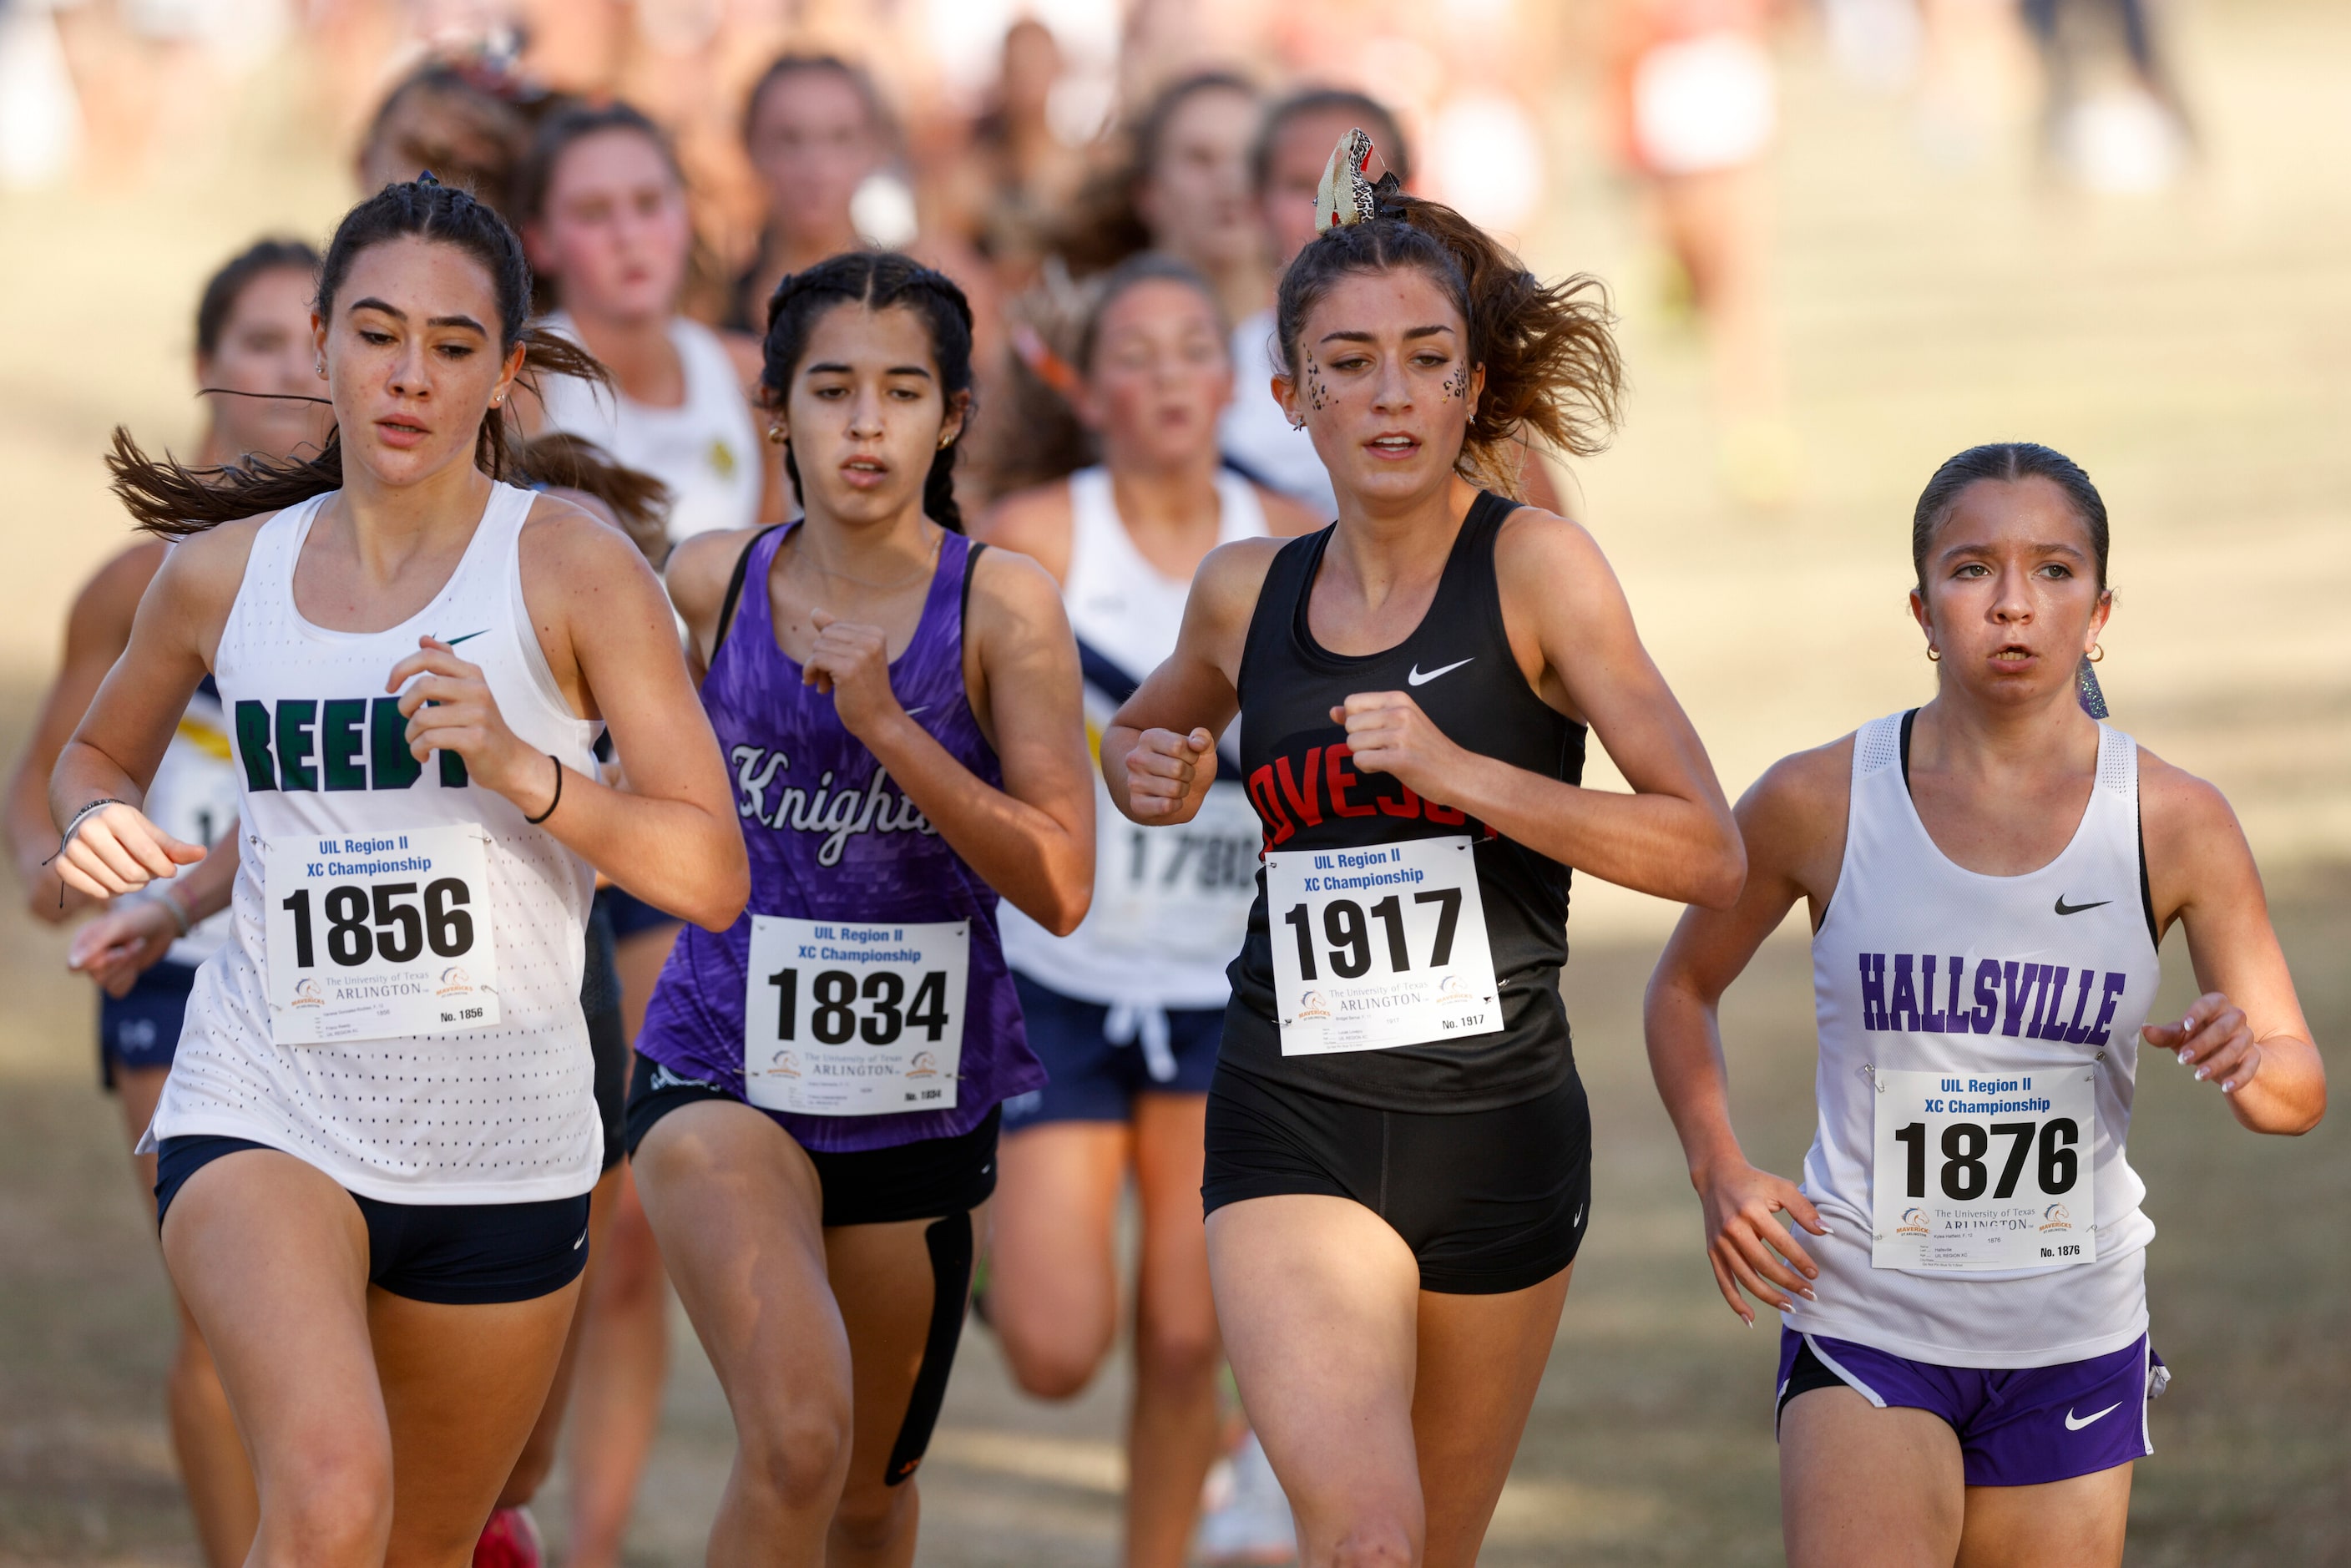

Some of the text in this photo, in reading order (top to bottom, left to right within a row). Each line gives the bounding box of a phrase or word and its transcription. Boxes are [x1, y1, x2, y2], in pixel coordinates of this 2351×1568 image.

[1249, 740, 1498, 862] OVEJ
[319, 836, 408, 855] UIL Region II
[306, 857, 432, 877] XC Championship
[1314, 848, 1401, 870] UIL Region II
[1304, 868, 1424, 892] XC Championship
[282, 878, 474, 968] 1856
[815, 927, 902, 943] UIL Region II
[1285, 888, 1463, 981] 1917
[799, 945, 921, 964] XC Championship
[326, 971, 429, 986] The University of Texas
[336, 983, 421, 1000] ARLINGTON
[1329, 981, 1429, 999] The University of Texas
[768, 968, 948, 1045] 1834
[1341, 993, 1421, 1011] ARLINGTON
[1858, 953, 2126, 1046] HALLSVILLE
[441, 1007, 483, 1022] No. 1856
[1298, 1009, 1331, 1018] MAVERICKS
[1442, 1014, 1484, 1029] No. 1917
[805, 1053, 822, 1061] The
[823, 1054, 865, 1064] University
[812, 1064, 894, 1076] ARLINGTON
[1941, 1077, 2031, 1095] UIL Region II
[1925, 1097, 2050, 1115] XC Championship
[1895, 1117, 2079, 1201] 1876
[1935, 1207, 2035, 1219] The University of Texas
[2039, 1222, 2072, 1232] MAVERICKS
[2040, 1245, 2081, 1257] No. 1876
